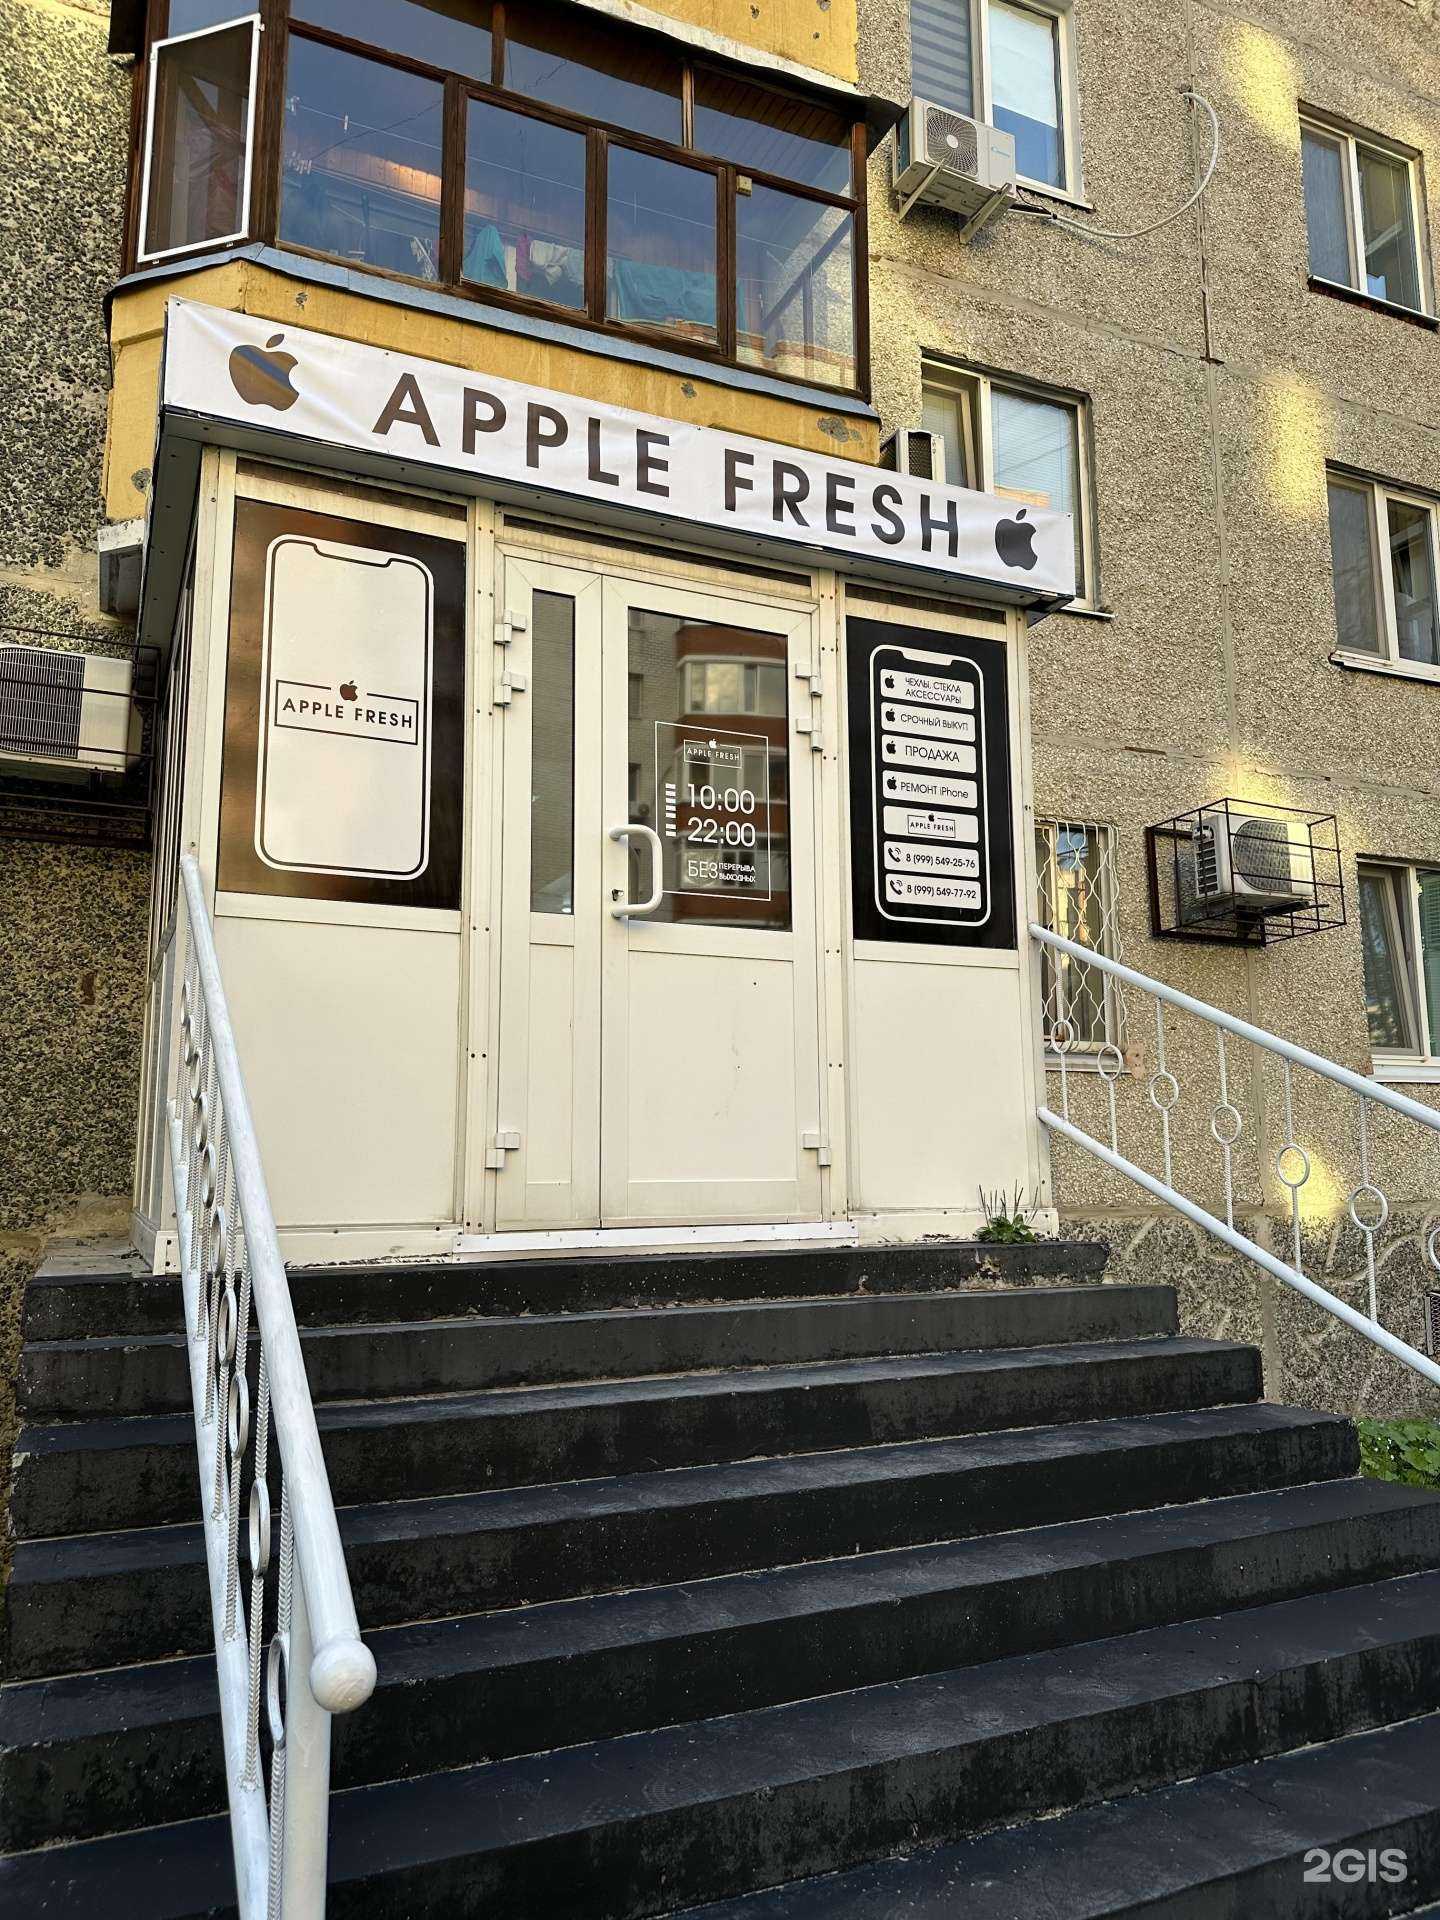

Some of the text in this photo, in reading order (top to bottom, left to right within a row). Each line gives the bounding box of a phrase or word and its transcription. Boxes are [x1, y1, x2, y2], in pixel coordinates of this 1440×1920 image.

[372, 372, 960, 558] APPLE FRESH
[905, 688, 962, 704] АКСЕССУАРЫ
[933, 681, 962, 694] СТЕКЛА
[282, 698, 412, 728] APPLE FRESH
[900, 713, 969, 731] СРОЧНЫЙ ВЫКУП
[686, 747, 740, 761] APPLE FRESH
[905, 745, 960, 762] ПРОДАЖА
[687, 783, 755, 814] 10:00
[900, 781, 969, 799] РЕМОНТ iPhone
[687, 817, 756, 847] 22:00
[910, 821, 954, 832] APPLE FRESH
[688, 860, 756, 879] БЕЗ ПЕРЕРЫВА
[906, 854, 976, 869] 8 (999) 549-25-76
[907, 884, 977, 899] 8 (999) 549-77-92
